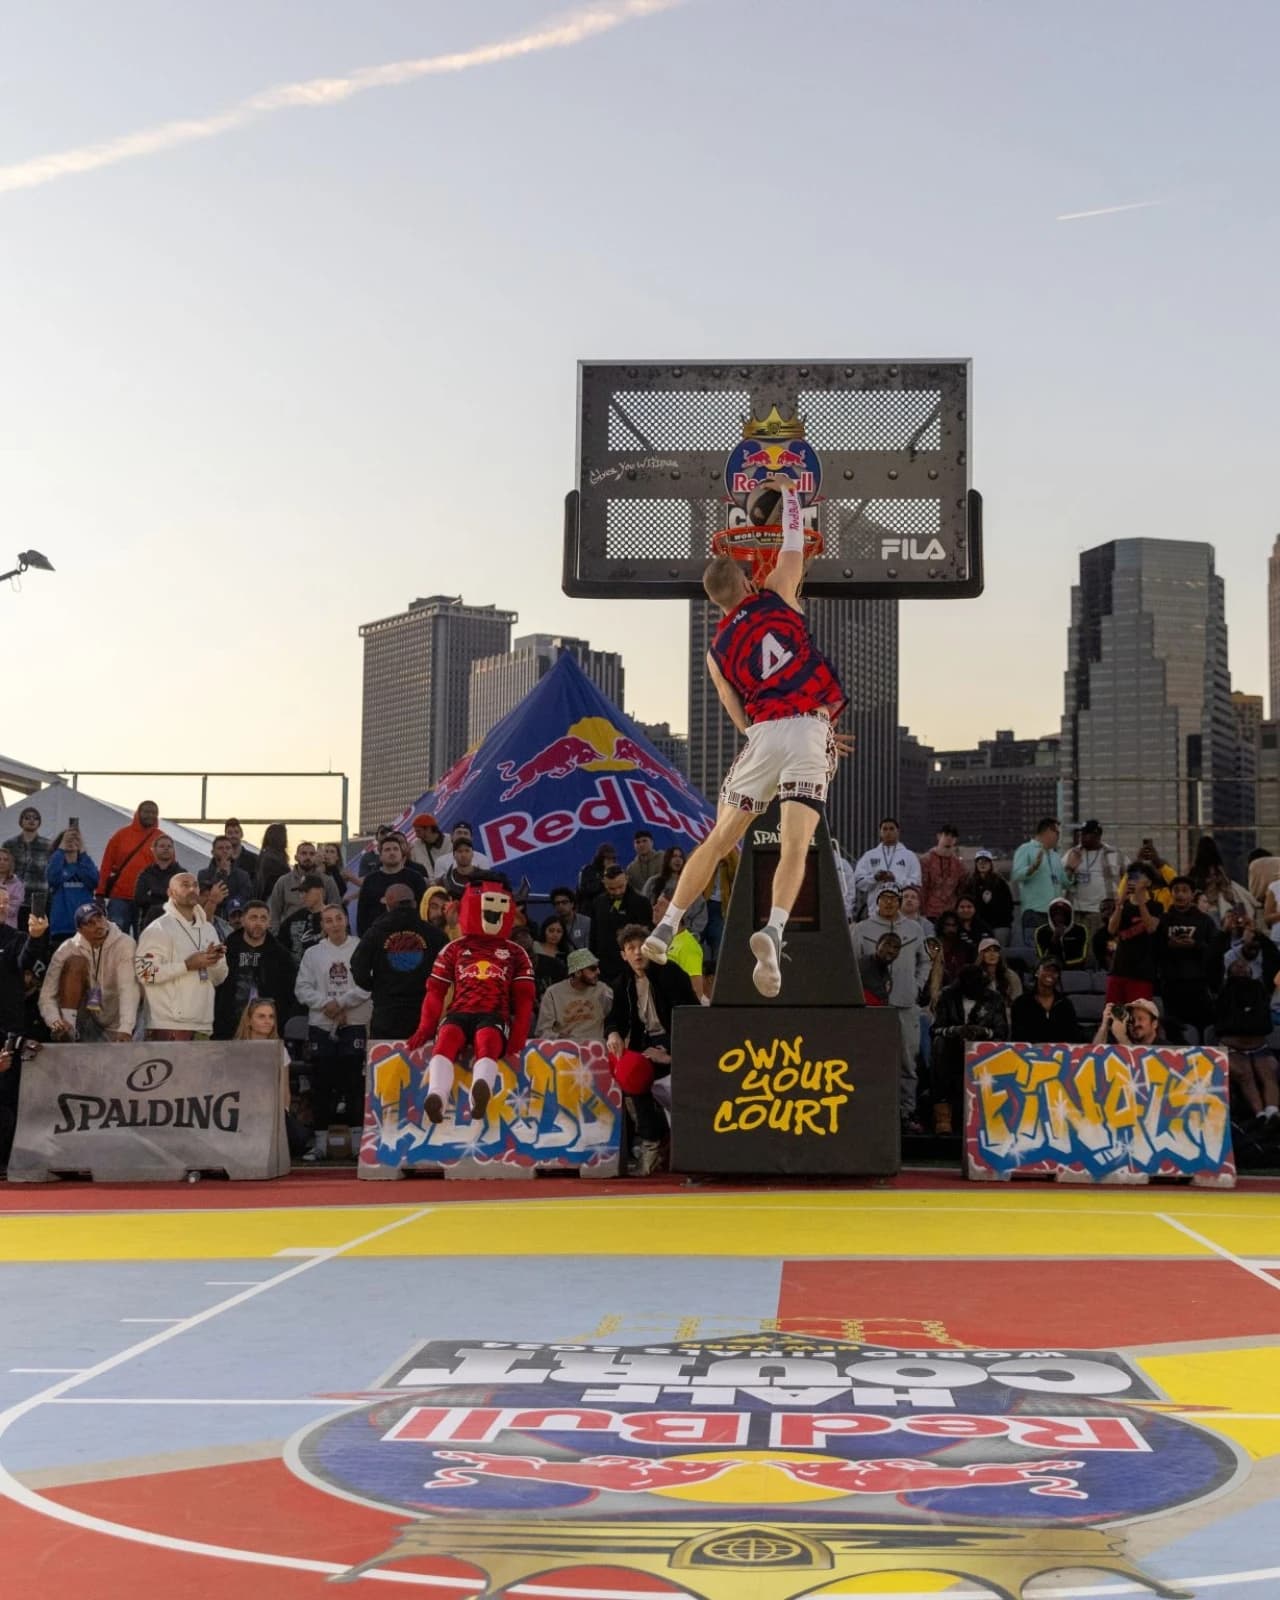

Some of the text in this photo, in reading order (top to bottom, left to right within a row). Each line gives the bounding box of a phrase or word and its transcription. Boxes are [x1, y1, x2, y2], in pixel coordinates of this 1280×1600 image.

[881, 538, 946, 560] FILA
[760, 632, 794, 681] 4
[479, 776, 632, 867] Red
[625, 778, 718, 845] Bu
[718, 1035, 803, 1073] OWN
[735, 1059, 855, 1104] YOUR
[54, 1091, 240, 1134] SPALDING
[713, 1094, 848, 1136] COURT
[972, 1048, 1227, 1166] FINALS
[397, 1348, 1133, 1395] COURT
[643, 1348, 837, 1359] FINALS
[861, 1350, 1066, 1360] WORLD
[580, 1384, 957, 1407] HALF
[379, 1406, 1153, 1452] Red Bull
